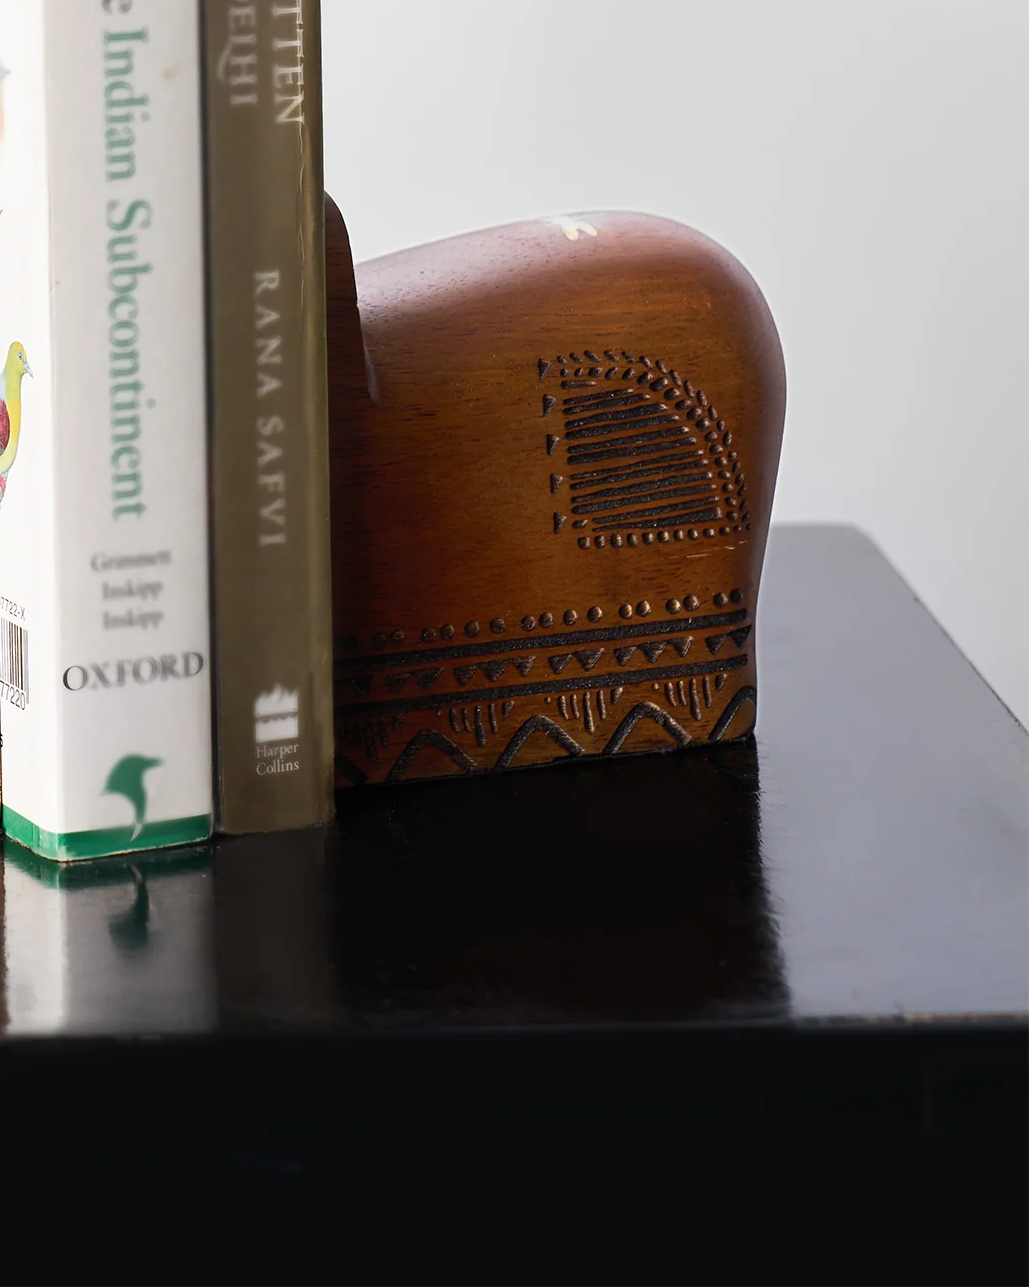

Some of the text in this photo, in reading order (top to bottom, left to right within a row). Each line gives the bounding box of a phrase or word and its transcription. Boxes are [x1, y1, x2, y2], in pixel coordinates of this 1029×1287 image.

[104, 27, 150, 182] Indian
[106, 198, 157, 521] Subcontinent
[254, 268, 287, 547] RANA SAFVI
[62, 651, 205, 692] OXFORD
[256, 743, 299, 759] Harper
[256, 759, 300, 776] Collins
